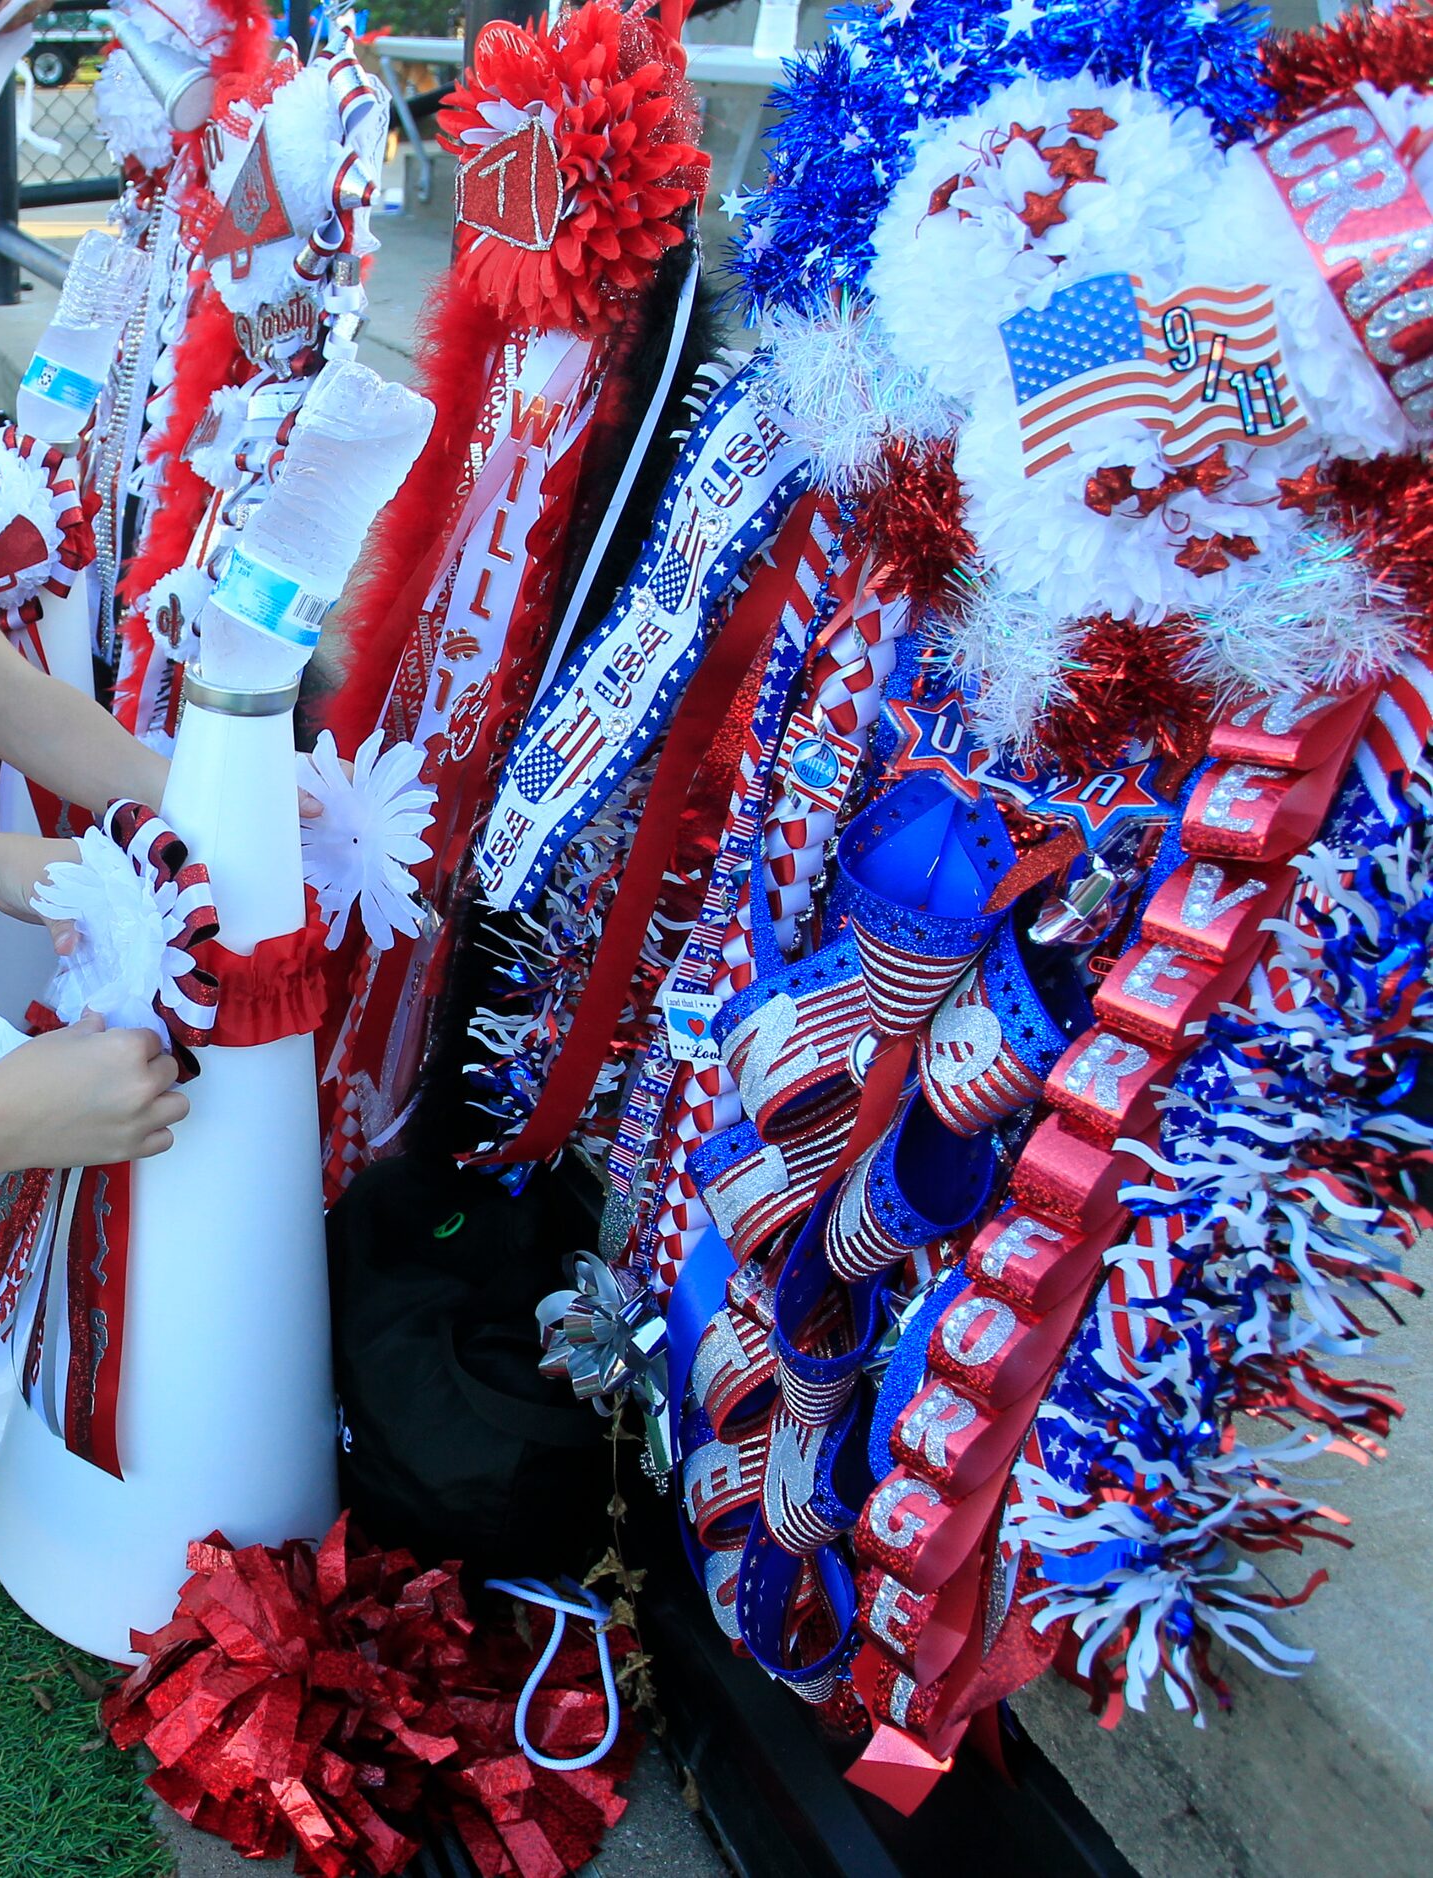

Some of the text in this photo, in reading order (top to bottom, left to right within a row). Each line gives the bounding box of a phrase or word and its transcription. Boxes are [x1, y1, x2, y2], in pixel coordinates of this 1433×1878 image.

[235, 290, 316, 360] Varsity
[1162, 306, 1285, 436] 9/11
[700, 412, 791, 508] USA
[594, 620, 673, 708] USA
[800, 764, 823, 784] BLUE
[478, 806, 535, 893] USA
[681, 999, 694, 1009] that
